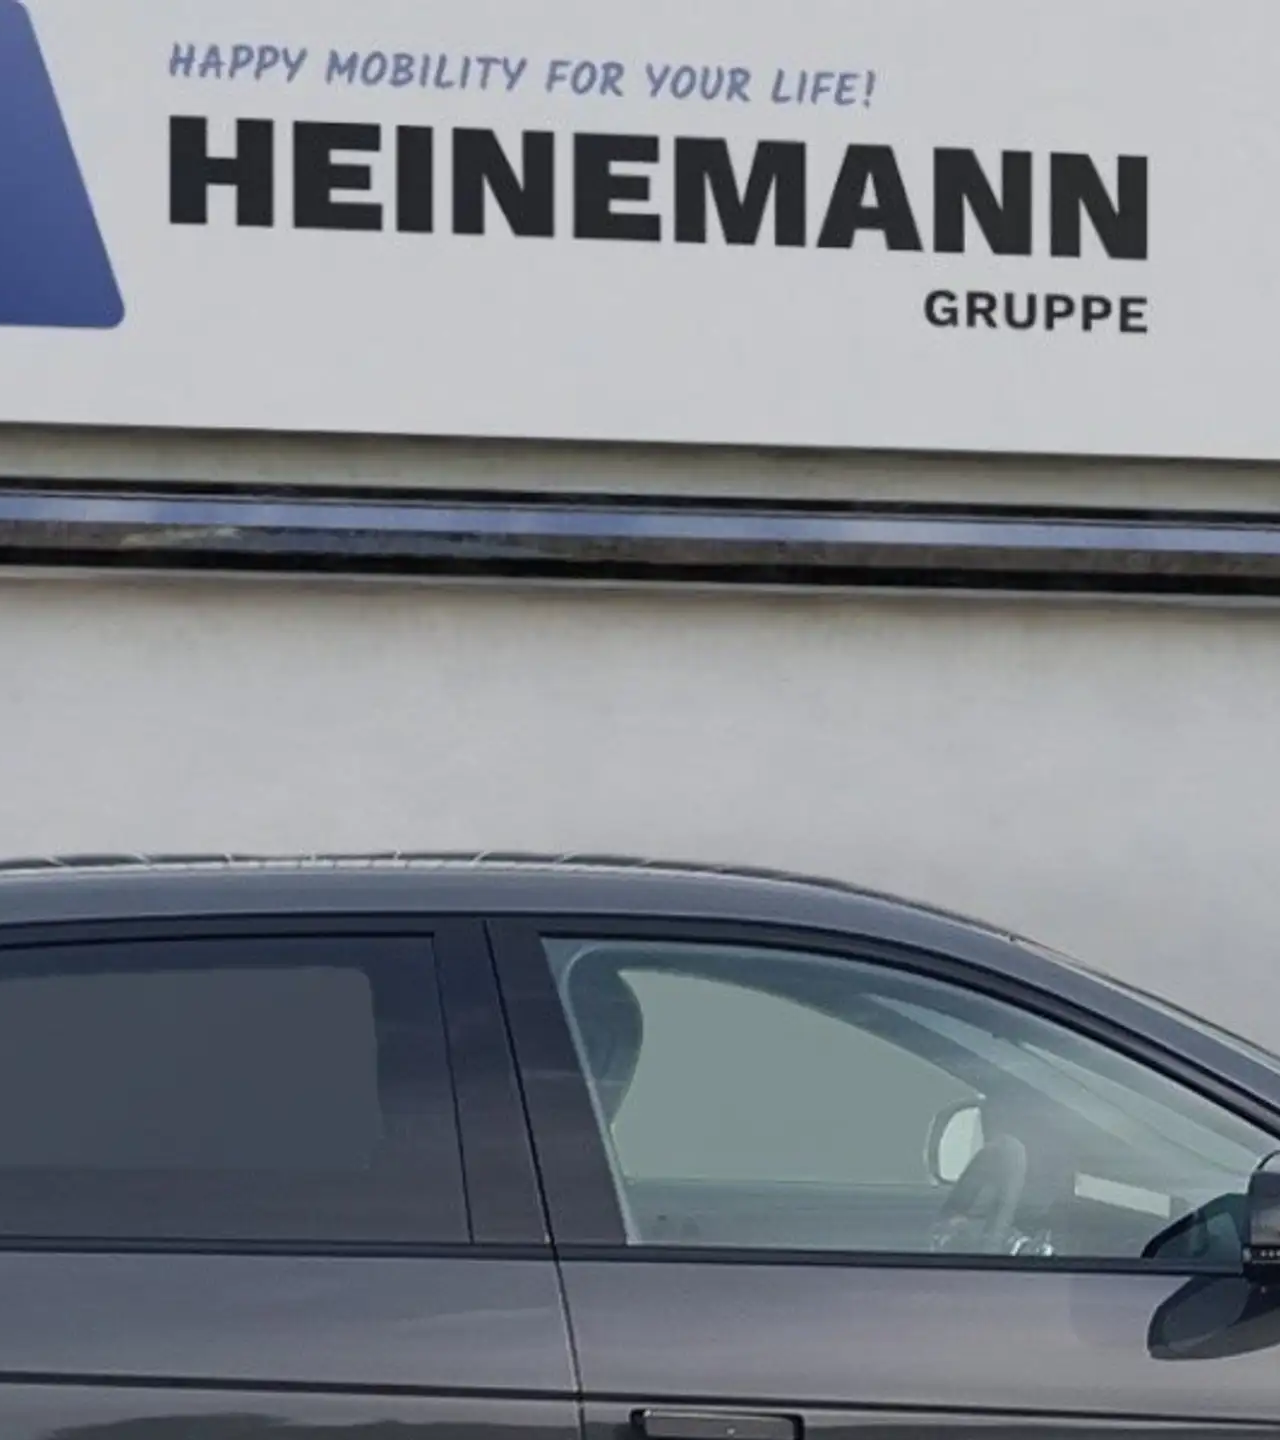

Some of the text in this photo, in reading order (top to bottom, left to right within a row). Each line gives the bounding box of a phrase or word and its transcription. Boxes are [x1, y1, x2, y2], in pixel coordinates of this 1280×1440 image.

[168, 42, 877, 109] HAPPY MOBILITY FOR YOUR LIFE!
[169, 115, 1148, 261] HEINEMANN
[923, 289, 1148, 334] GRUPPE
